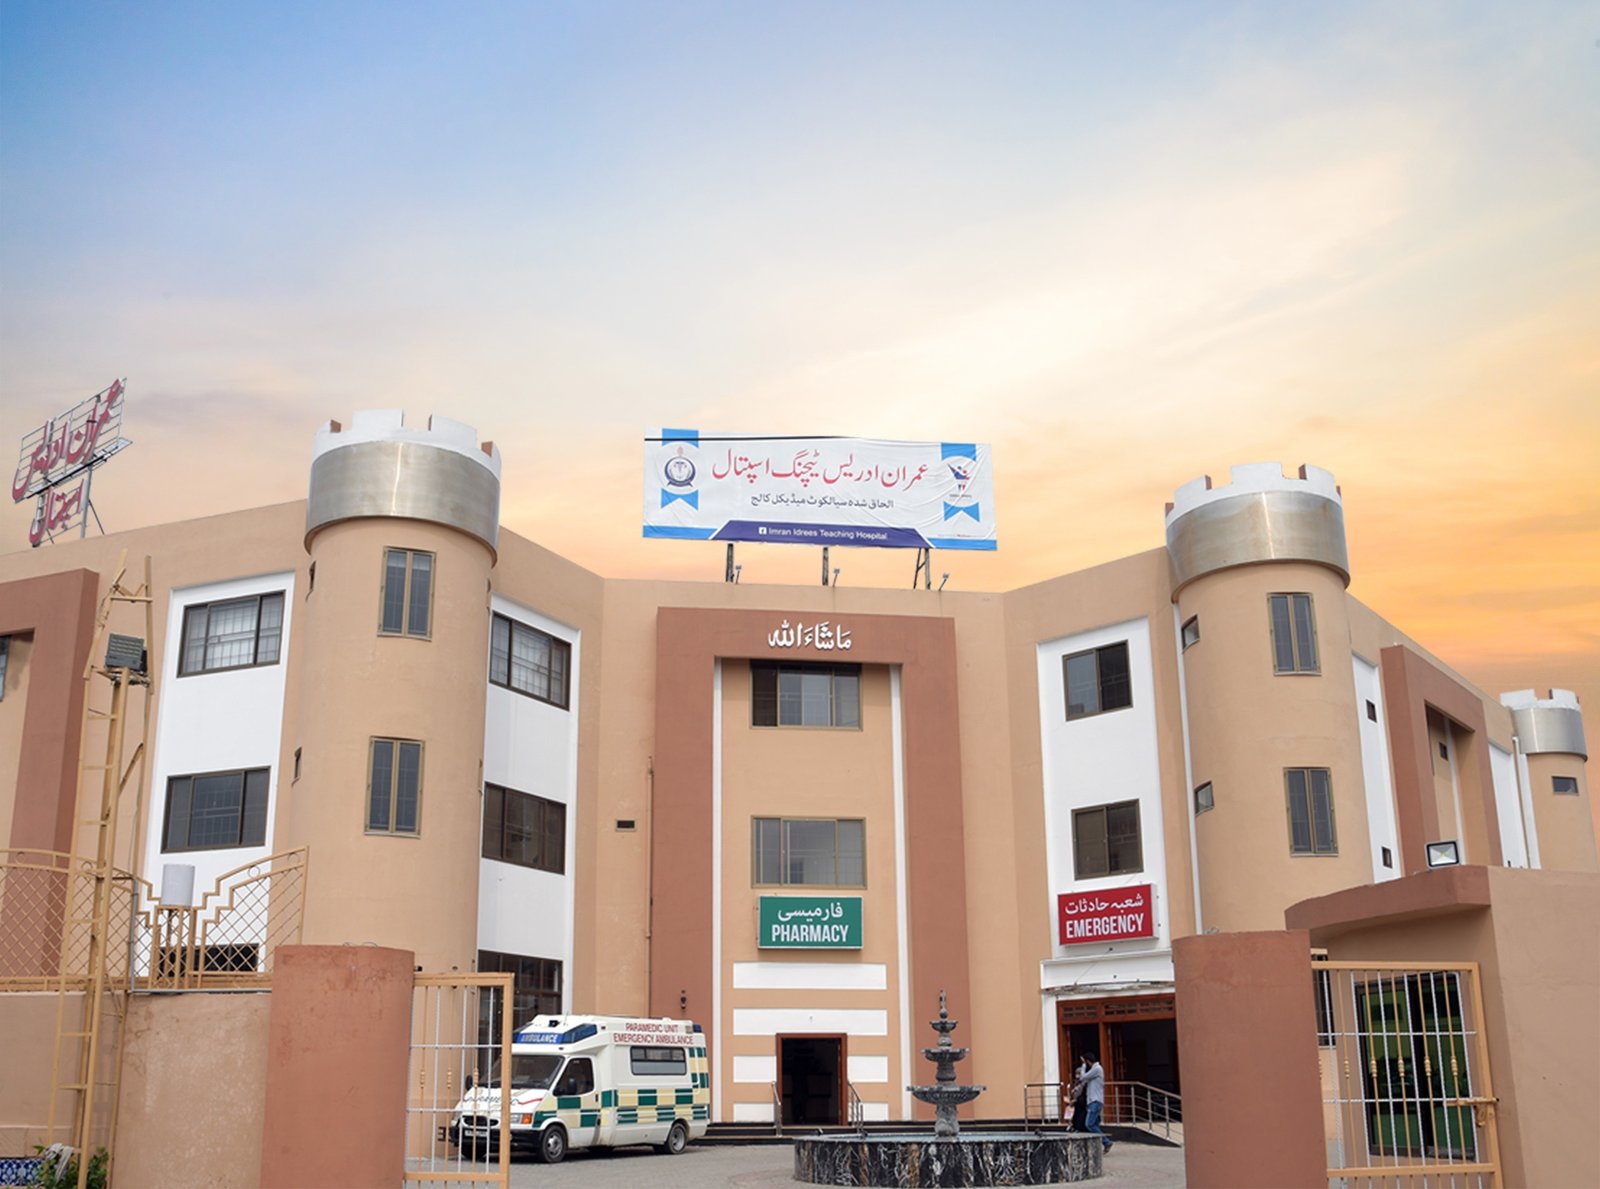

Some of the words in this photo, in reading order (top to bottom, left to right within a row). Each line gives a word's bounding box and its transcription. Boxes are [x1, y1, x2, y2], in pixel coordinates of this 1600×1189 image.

[711, 448, 770, 484] اسپتال
[771, 448, 820, 487] ٹیچنگ
[822, 453, 879, 484] ادریس
[881, 464, 929, 491] عمران
[751, 492, 771, 506] کالج
[806, 495, 848, 508] سیالکوٹ
[848, 498, 867, 507] شدہ
[868, 498, 894, 510] الحاق
[768, 527, 792, 536] Imran
[792, 528, 818, 537] Idrees
[819, 529, 855, 540] Teaching
[855, 531, 887, 541] Hospital
[777, 901, 844, 923] فارمیسی
[1064, 896, 1110, 915] حادثات
[1110, 892, 1145, 914] شعبہ
[771, 923, 849, 943] PHARMACY
[1065, 912, 1145, 939] EMERGENCY
[625, 1022, 663, 1033] PARAMEDIC
[664, 1023, 679, 1033] UNIT
[520, 1033, 559, 1043] AMBULANCE
[613, 1032, 654, 1044] EMERGENCY
[655, 1034, 695, 1045] AMBULANCE
